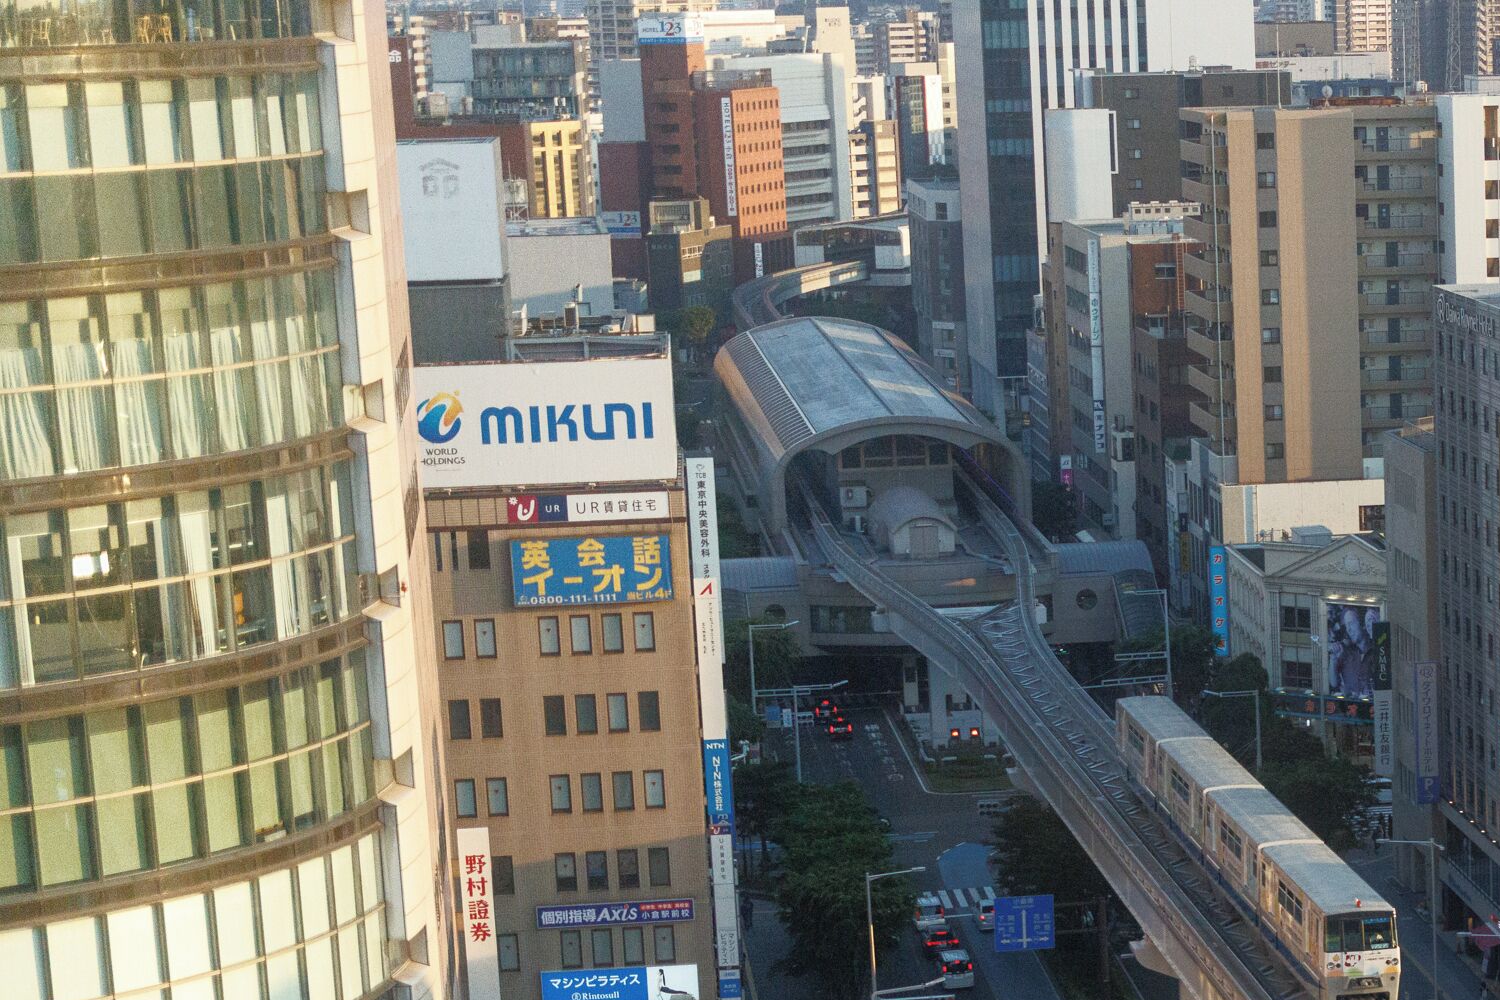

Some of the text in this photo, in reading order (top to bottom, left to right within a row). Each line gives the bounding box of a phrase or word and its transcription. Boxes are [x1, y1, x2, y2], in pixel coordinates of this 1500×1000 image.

[659, 21, 682, 36] 123
[425, 447, 458, 456] WORLD
[545, 504, 561, 513] UR
[576, 499, 658, 515] UR賃貸住宅
[696, 480, 711, 557] 東京中央美容外科
[520, 535, 661, 570] 英会話
[522, 564, 663, 596] イーオン
[530, 592, 618, 605] 0800-111-1111
[1378, 645, 1388, 682] SMBC
[1379, 699, 1391, 767] 三井住友銀行
[706, 742, 725, 750] NTN
[1423, 778, 1434, 790] P
[464, 852, 492, 942] 野村證券
[541, 903, 638, 925] 個別指導 Axis
[641, 909, 690, 920] 小倉駅前校
[549, 972, 641, 990] マシンピラティス
[582, 990, 620, 1000] Rintosull
